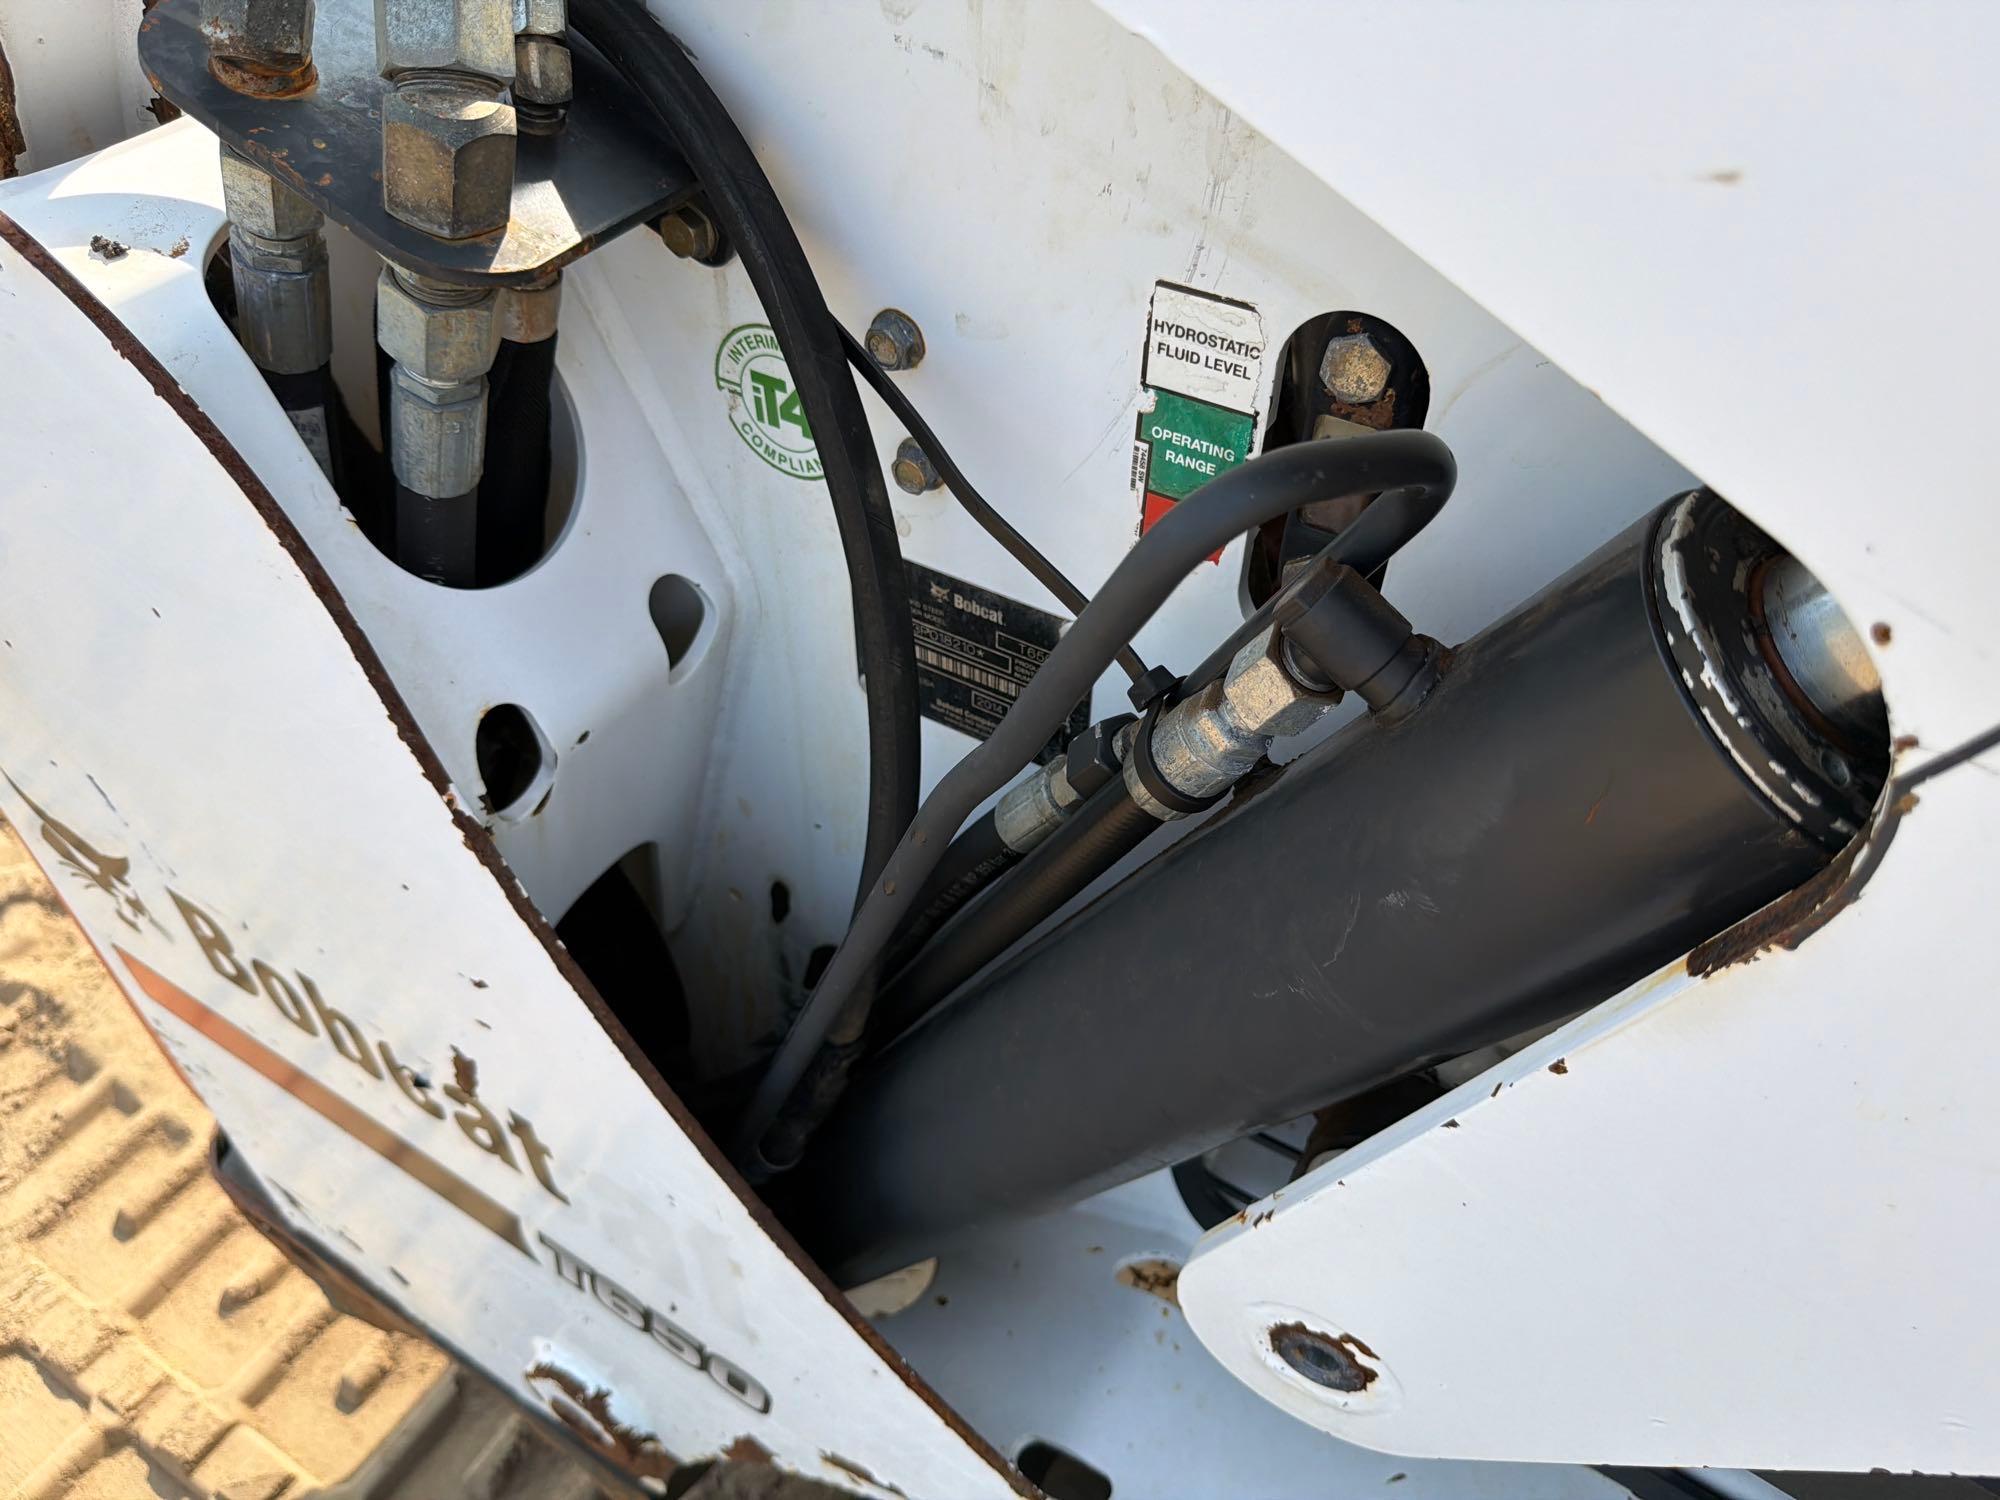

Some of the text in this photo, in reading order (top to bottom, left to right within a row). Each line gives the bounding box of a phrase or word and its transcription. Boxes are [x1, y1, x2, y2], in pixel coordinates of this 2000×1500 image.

[1153, 318, 1261, 360] HYDROSTATIC
[1156, 341, 1251, 381] FLUID LEVEL
[1151, 426, 1236, 462] OPERATING
[1165, 449, 1216, 476] RANGE
[953, 593, 1004, 626] Bobcat
[975, 695, 1004, 715] 2014
[164, 886, 572, 1206] Bobcat
[537, 1229, 774, 1415] T650
